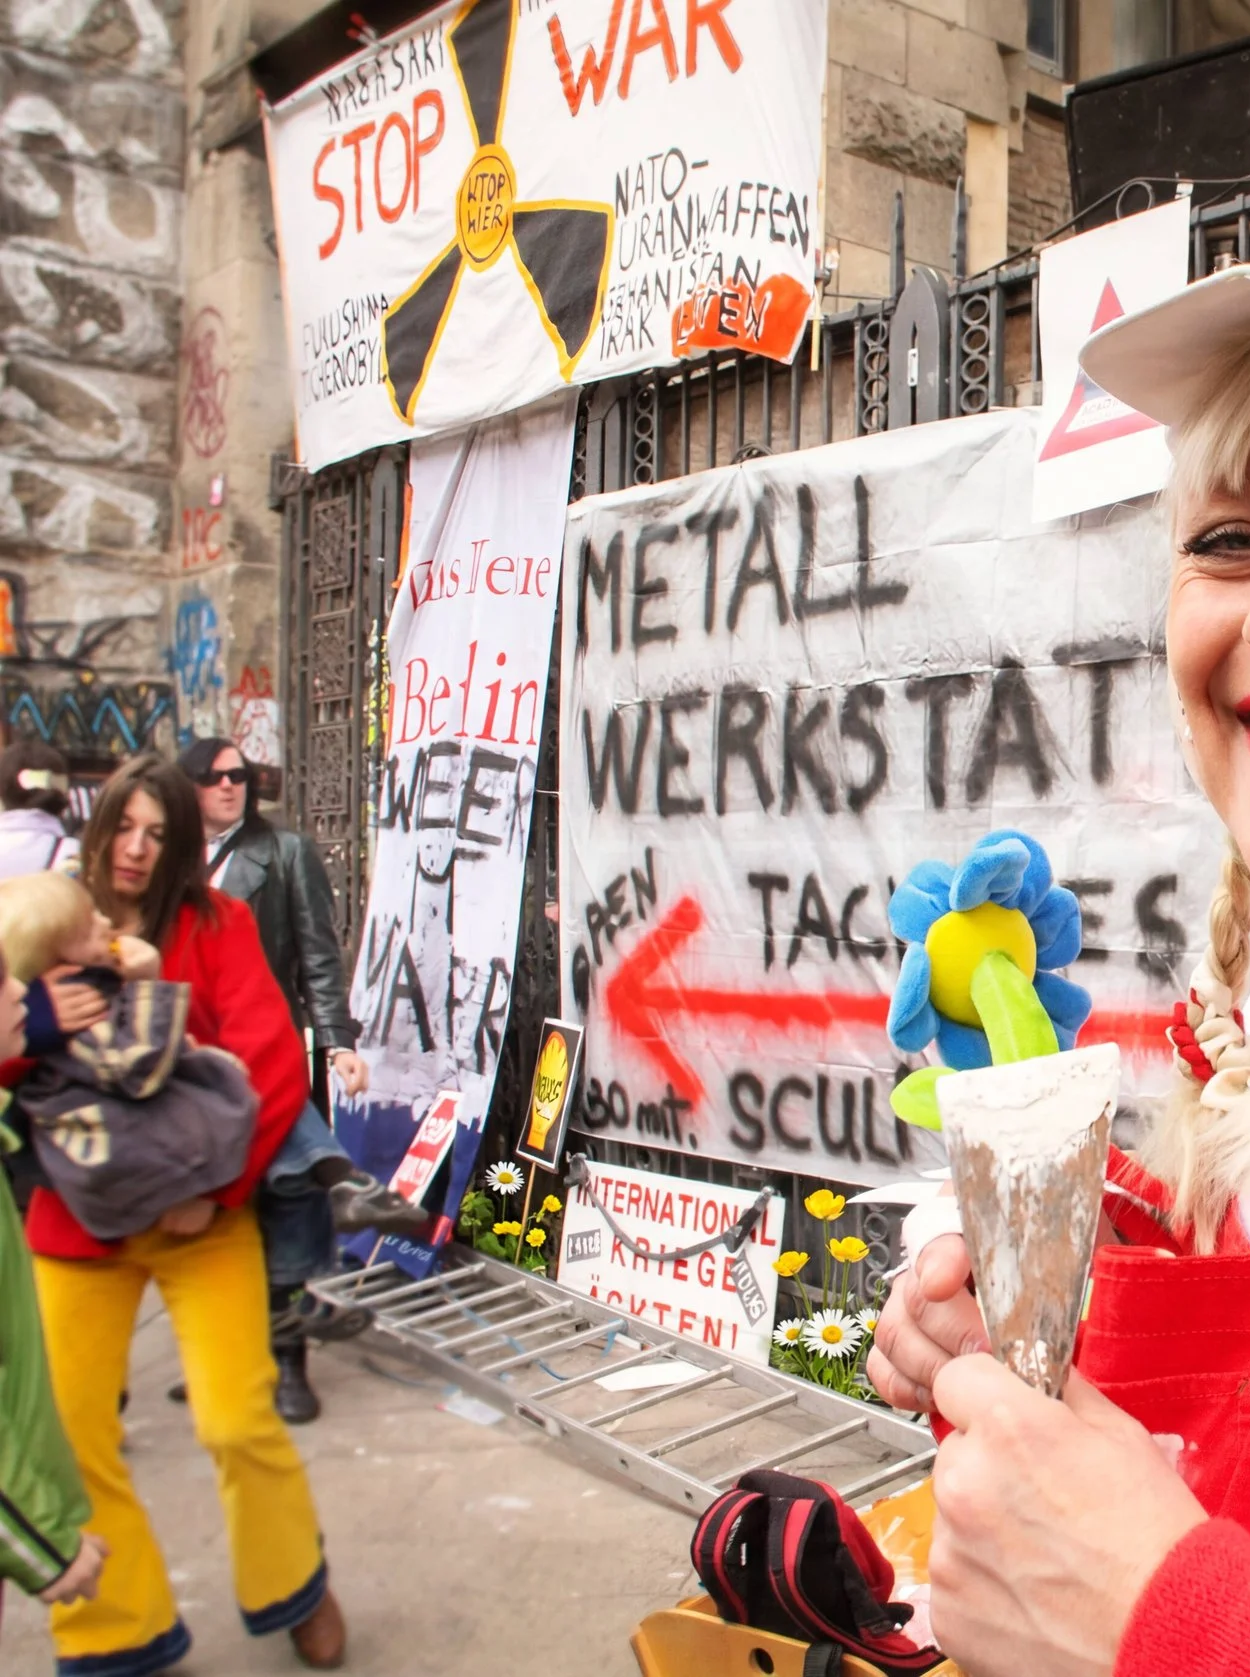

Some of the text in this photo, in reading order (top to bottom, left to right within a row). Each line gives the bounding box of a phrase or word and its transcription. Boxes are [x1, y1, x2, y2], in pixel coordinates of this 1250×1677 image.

[546, 0, 744, 117] WAR
[312, 89, 446, 260] STOP
[615, 148, 710, 215] NATO-
[616, 181, 810, 271] URANWAFFEN
[303, 292, 389, 363] FUKUSHIMA
[577, 473, 909, 655] METALL
[581, 634, 1168, 818] WERKSTAT
[571, 846, 658, 1016] OPEN
[576, 1175, 778, 1247] INTERNATIONL
[610, 1232, 738, 1294] KRIEGE
